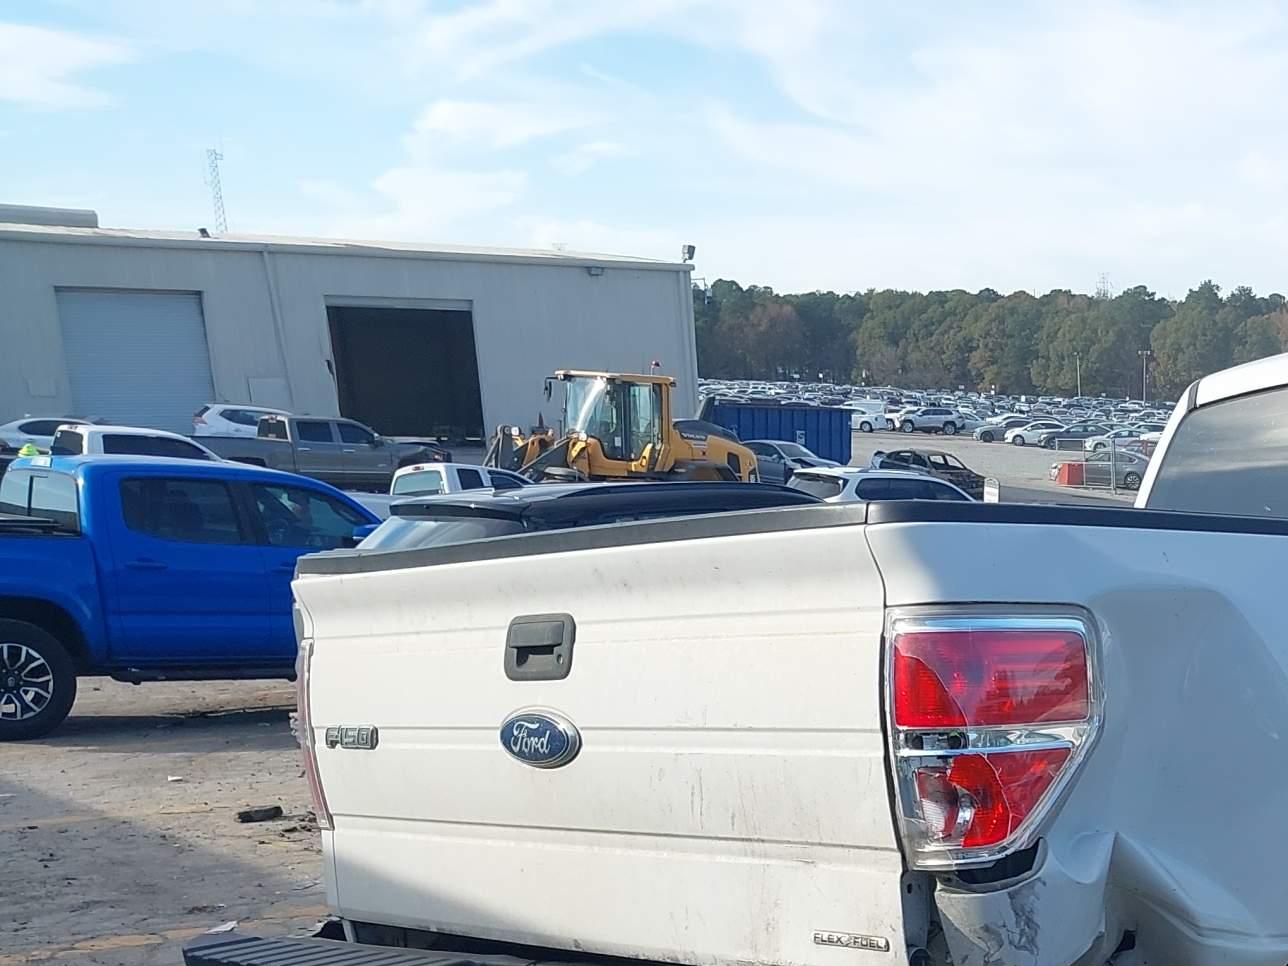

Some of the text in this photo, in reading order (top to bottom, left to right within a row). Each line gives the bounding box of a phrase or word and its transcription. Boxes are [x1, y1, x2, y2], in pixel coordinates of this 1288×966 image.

[511, 721, 551, 754] Ford
[813, 932, 887, 949] FLEX FUEL
